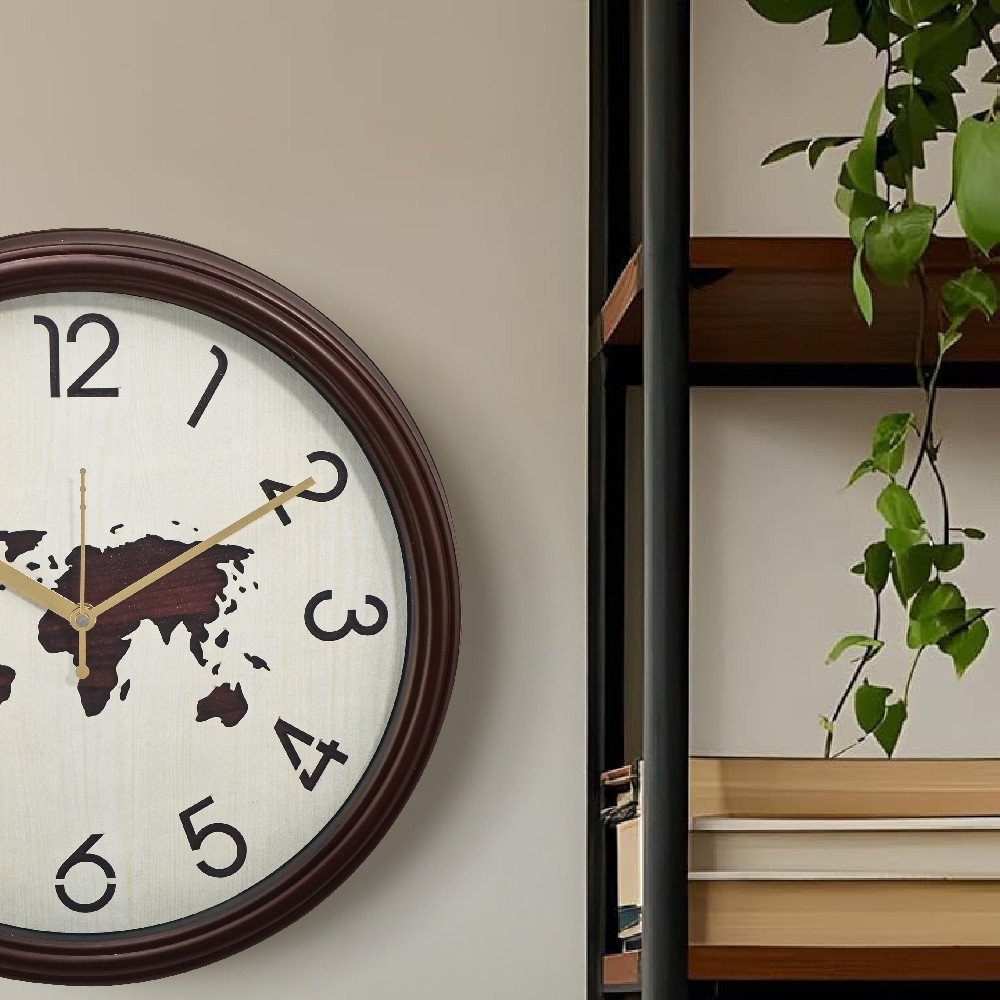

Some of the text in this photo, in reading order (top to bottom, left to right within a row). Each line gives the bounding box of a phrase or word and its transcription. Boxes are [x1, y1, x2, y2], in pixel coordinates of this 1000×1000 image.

[34, 313, 120, 398] 12
[187, 345, 229, 428] 1
[303, 589, 389, 642] 3
[274, 717, 349, 792] 4
[55, 834, 117, 914] 6
[179, 796, 248, 879] 5
